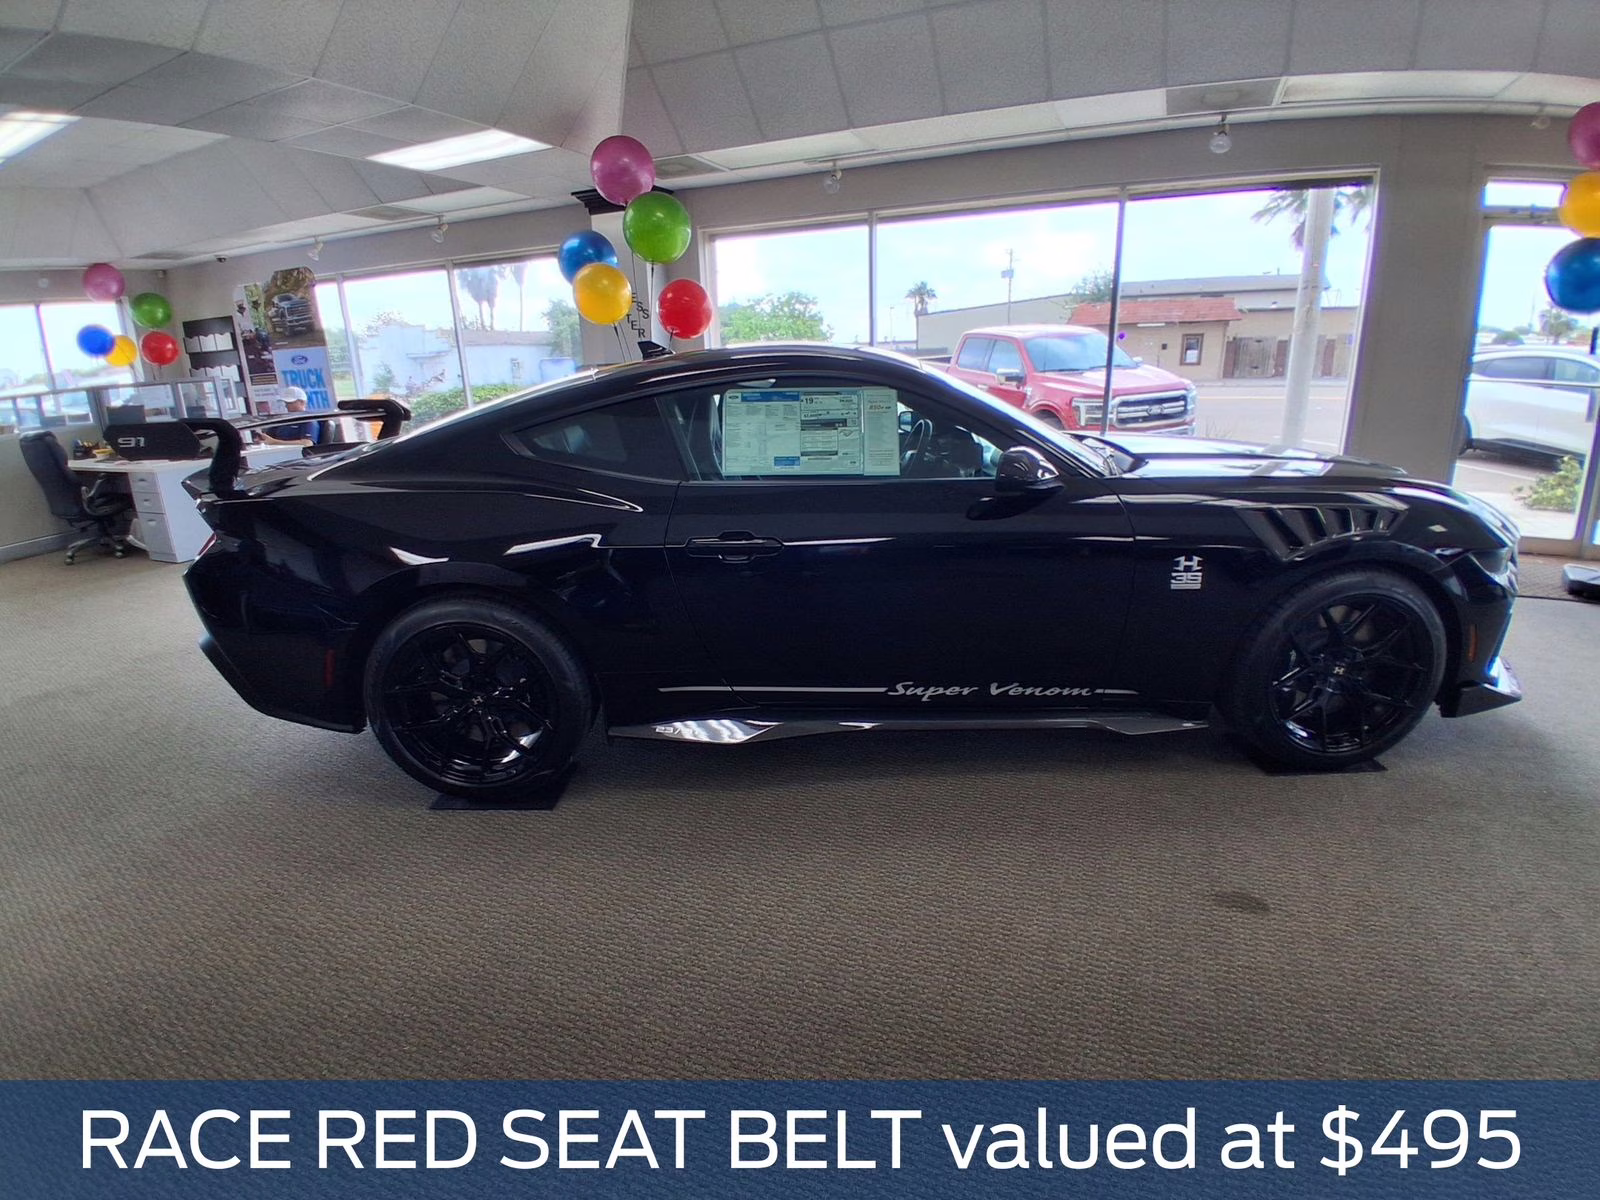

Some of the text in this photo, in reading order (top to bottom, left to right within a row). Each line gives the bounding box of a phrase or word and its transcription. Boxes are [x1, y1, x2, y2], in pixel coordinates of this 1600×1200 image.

[281, 367, 326, 390] TRUCK
[118, 437, 145, 448] 91
[886, 681, 1092, 702] Super Venom
